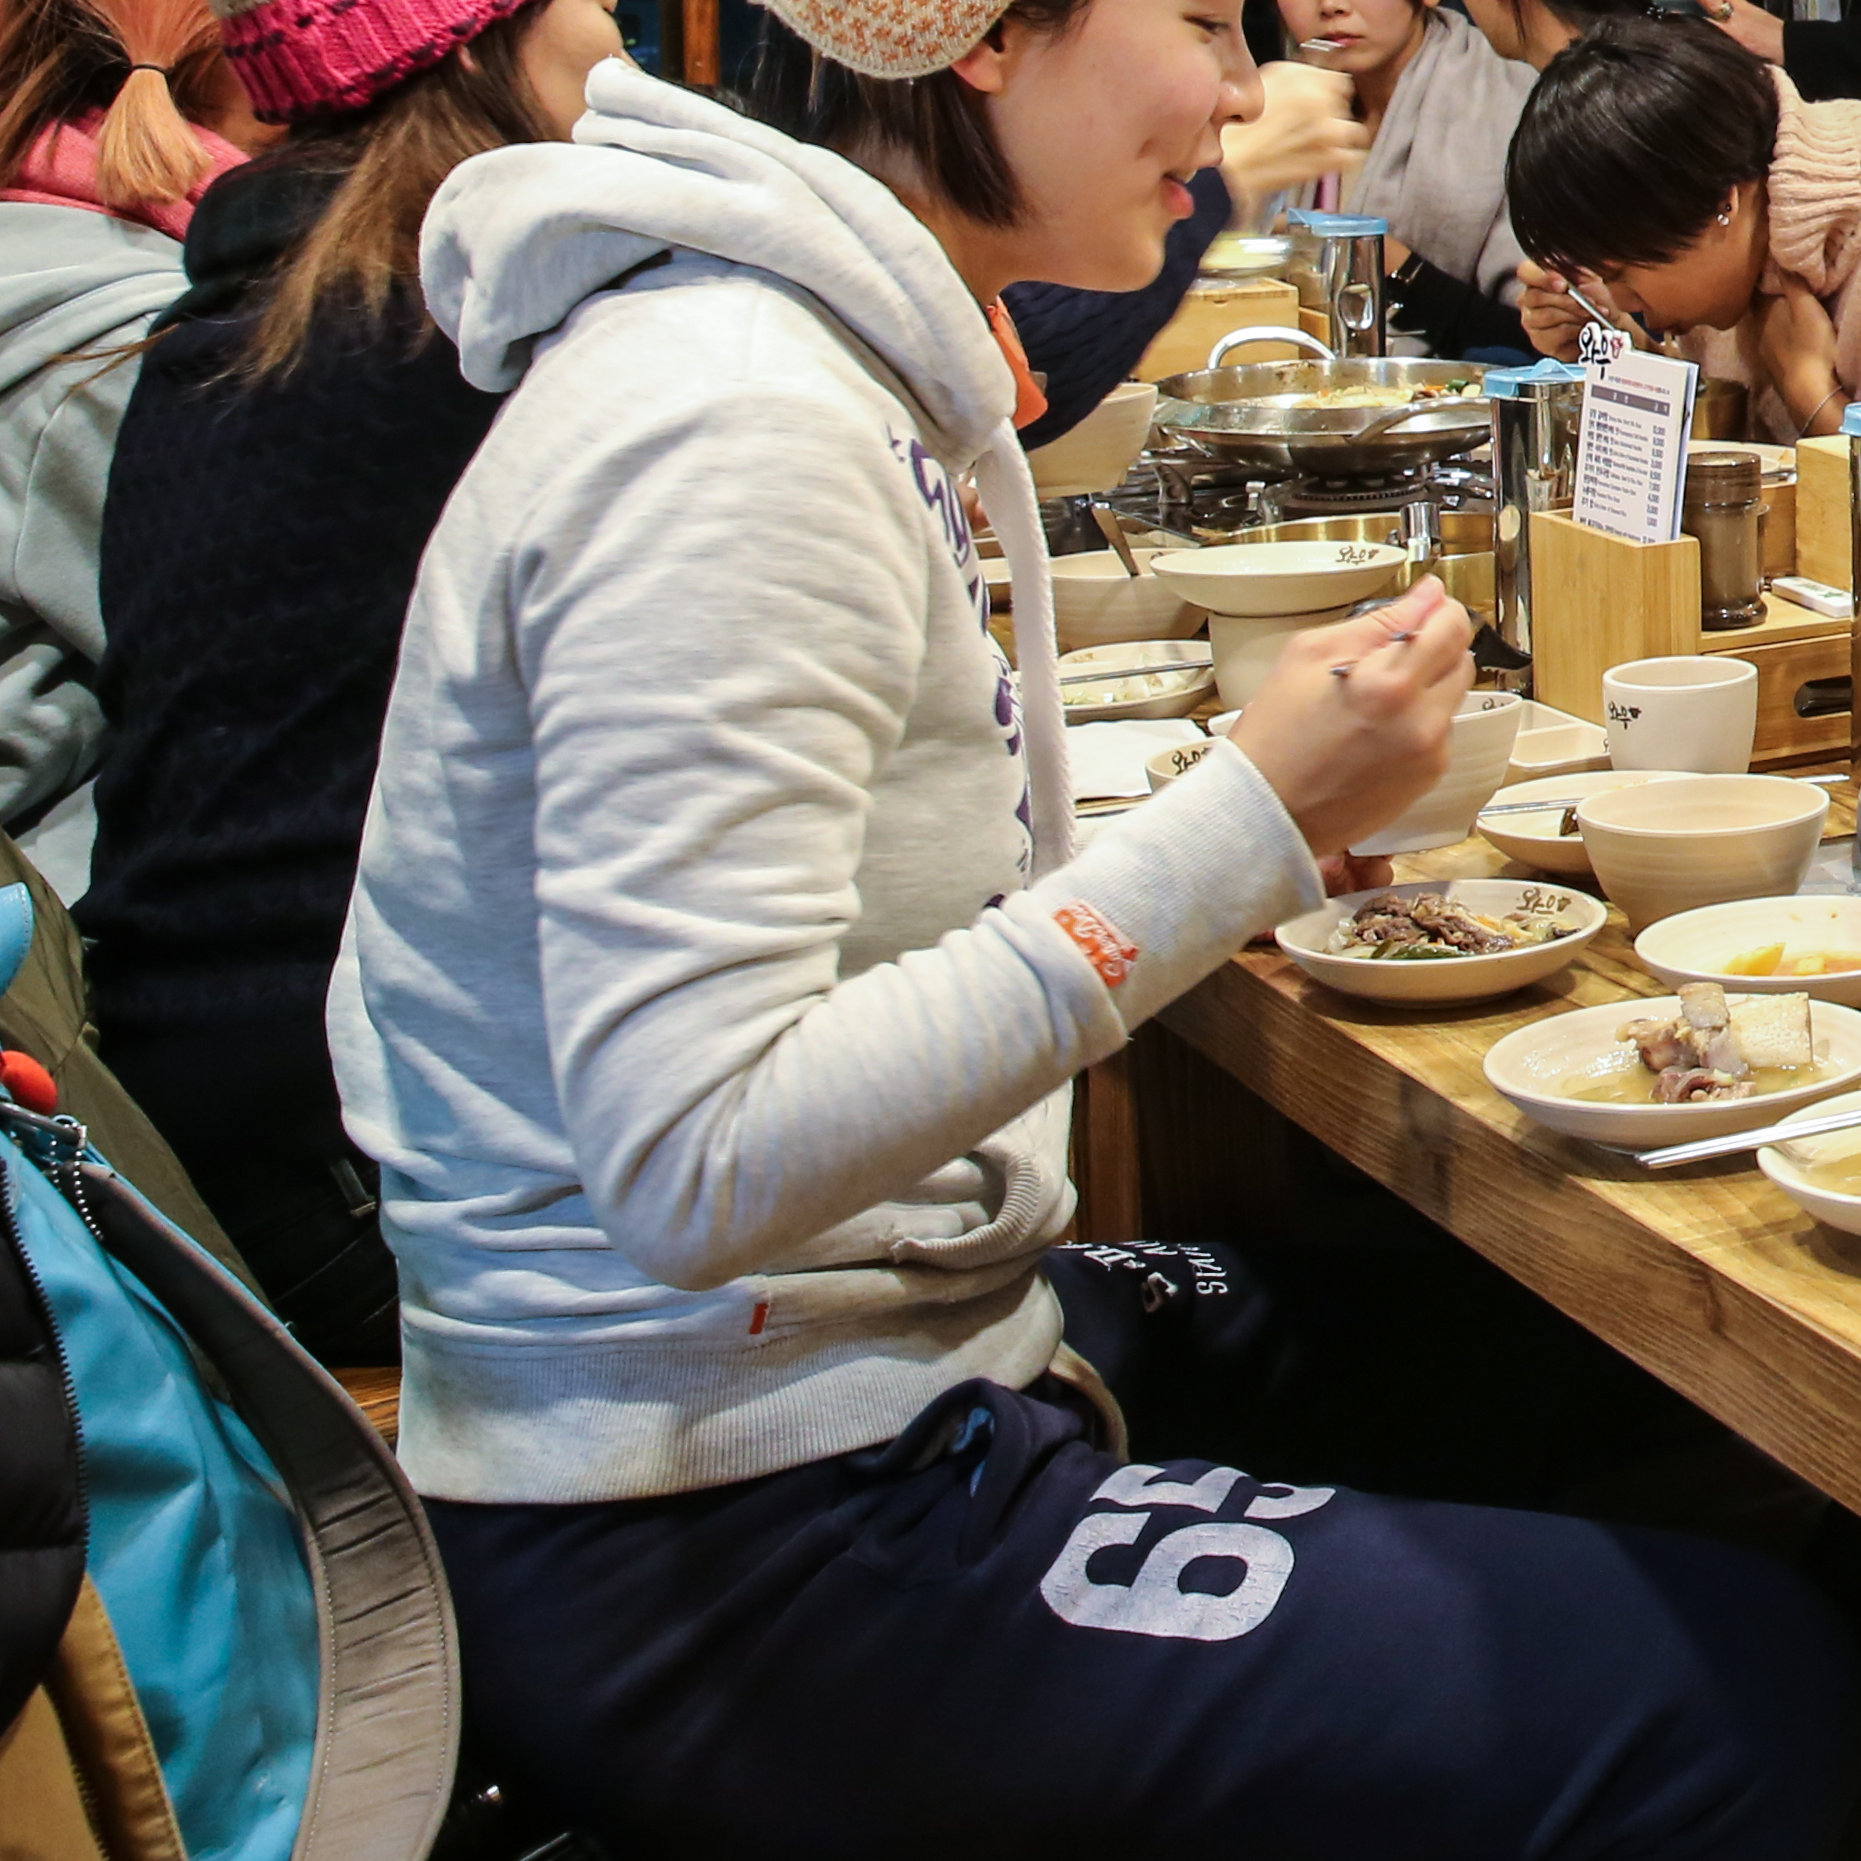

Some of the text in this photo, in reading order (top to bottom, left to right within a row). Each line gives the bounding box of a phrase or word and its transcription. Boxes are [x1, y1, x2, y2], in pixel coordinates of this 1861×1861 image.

[1580, 326, 1612, 380] 와우
[1335, 545, 1366, 566] 와우
[1608, 700, 1632, 730] 와우
[1516, 886, 1556, 915] 와우
